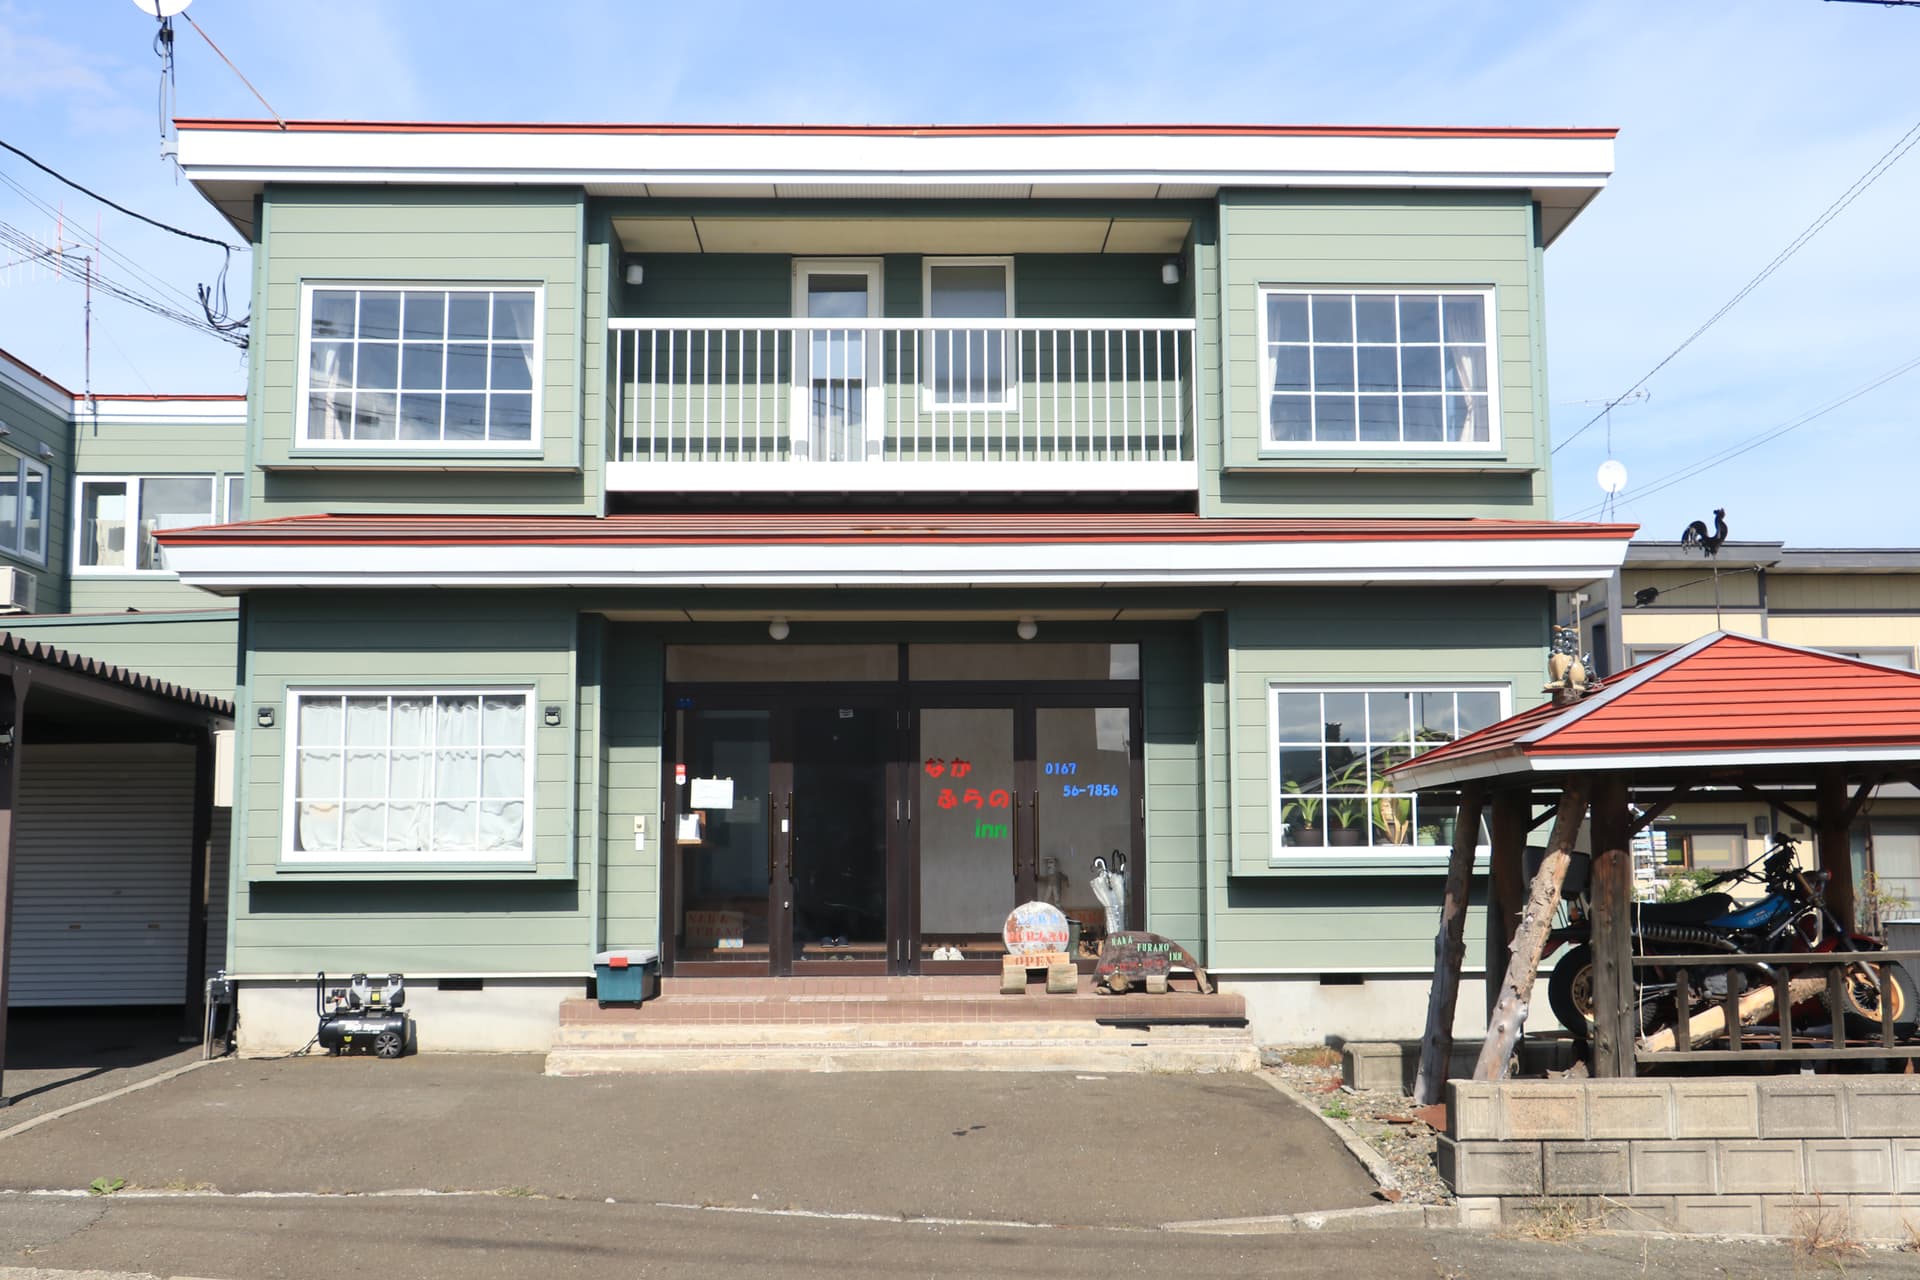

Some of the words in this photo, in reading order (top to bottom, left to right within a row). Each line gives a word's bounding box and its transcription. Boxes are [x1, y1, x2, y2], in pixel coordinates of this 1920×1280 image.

[925, 757, 972, 778] なか
[1045, 763, 1077, 775] 0167
[1063, 784, 1119, 797] 56-7856
[937, 788, 1010, 809] ふらの
[975, 819, 1008, 838] inn
[1137, 943, 1170, 952] FURANO
[1015, 955, 1055, 967] OPEN
[1169, 952, 1183, 961] INN
